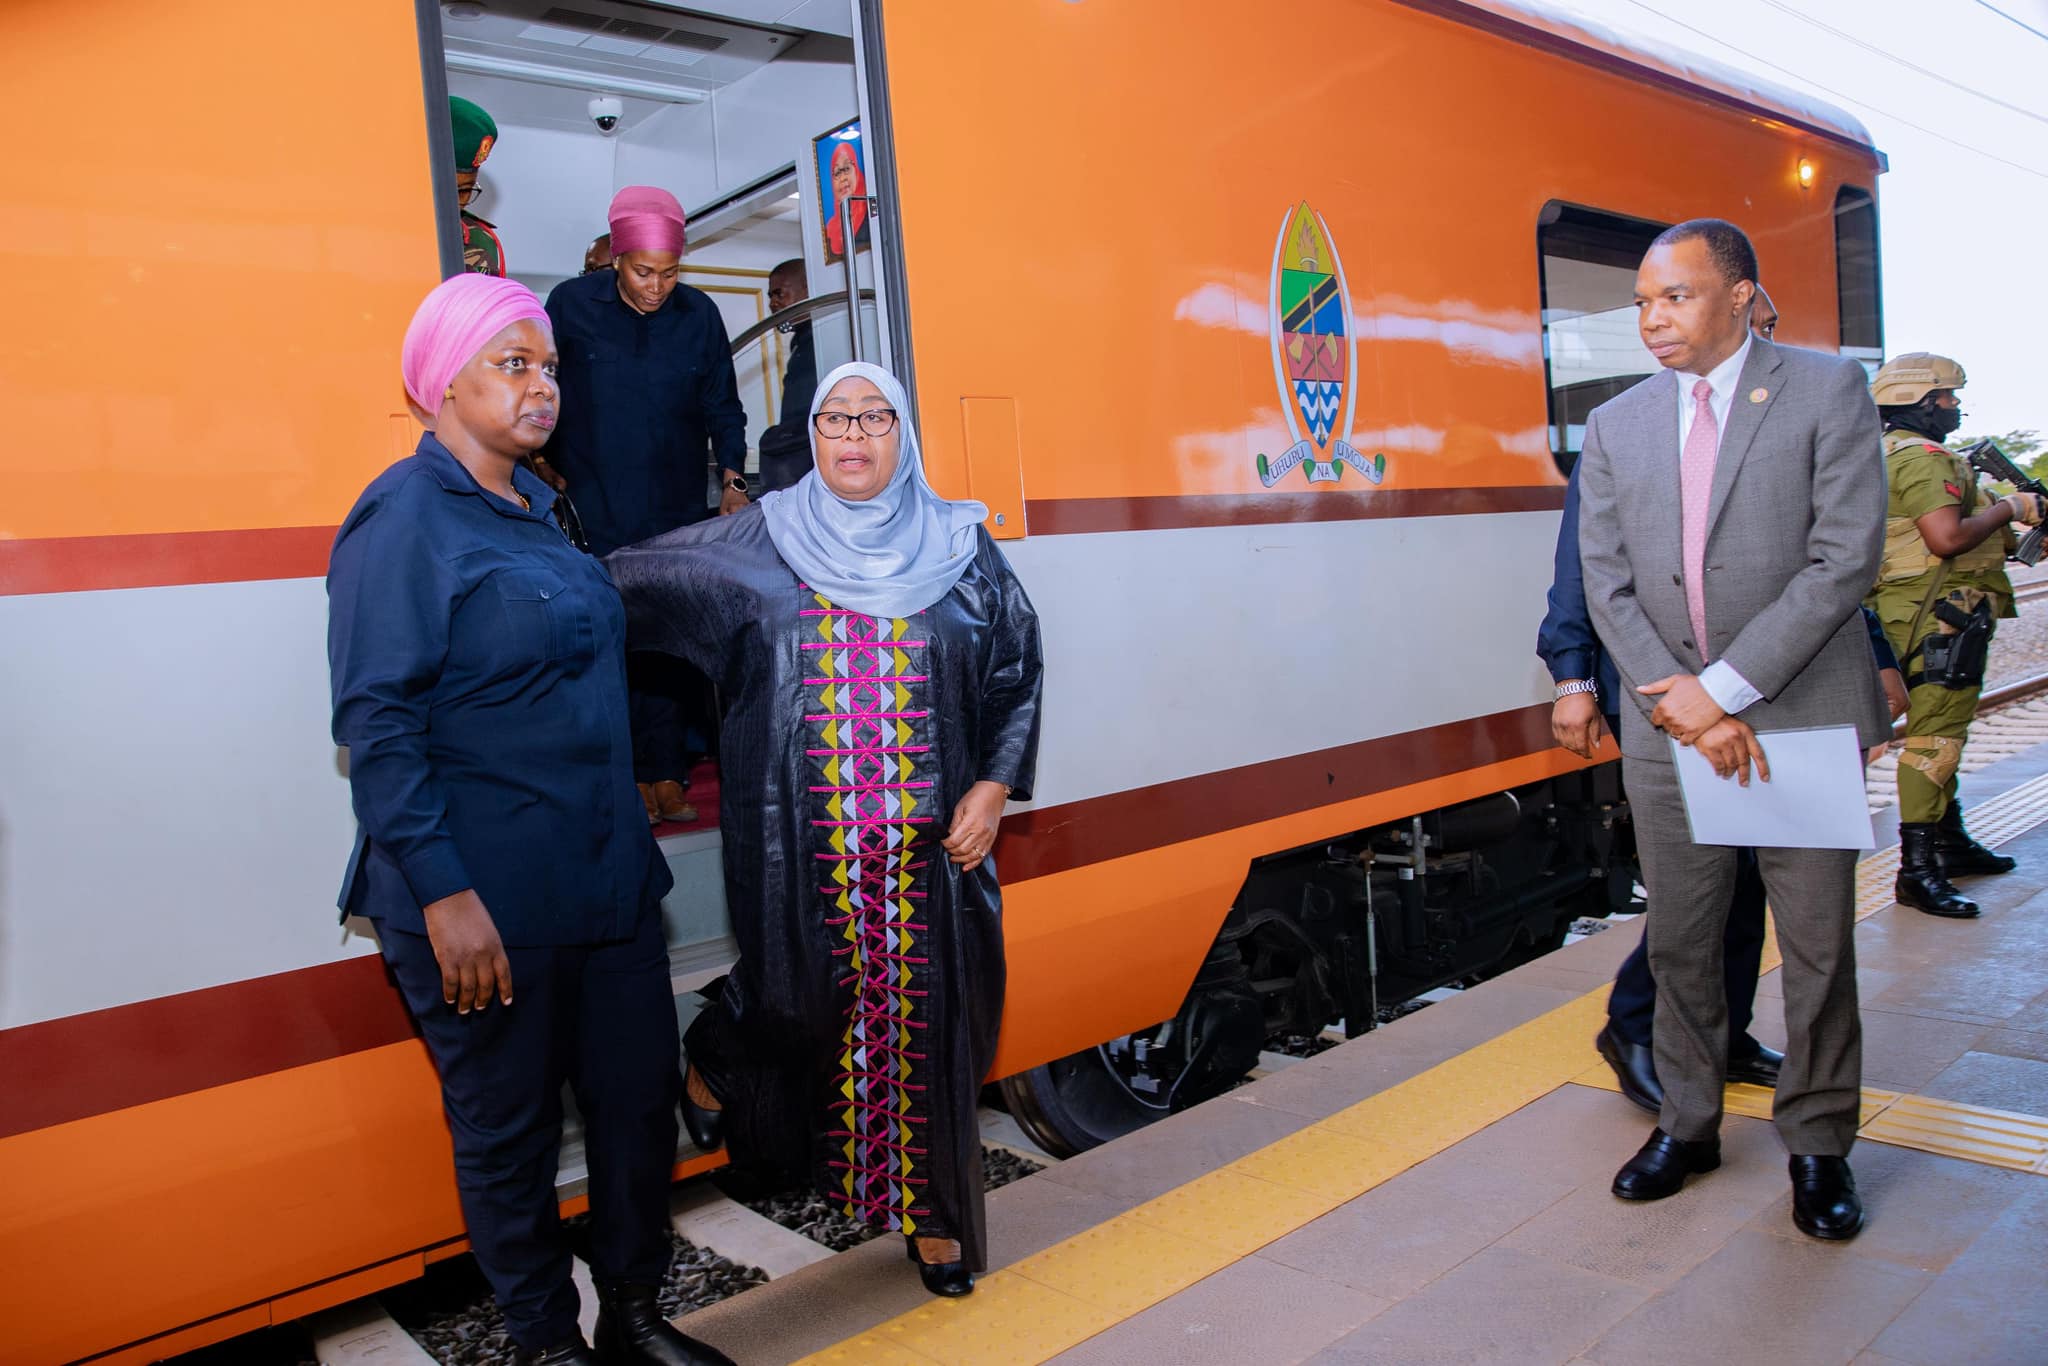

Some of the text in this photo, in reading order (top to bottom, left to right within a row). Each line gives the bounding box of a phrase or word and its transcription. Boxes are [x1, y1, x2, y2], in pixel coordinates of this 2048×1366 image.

[1270, 442, 1371, 479] UHURU NA UMOJA
